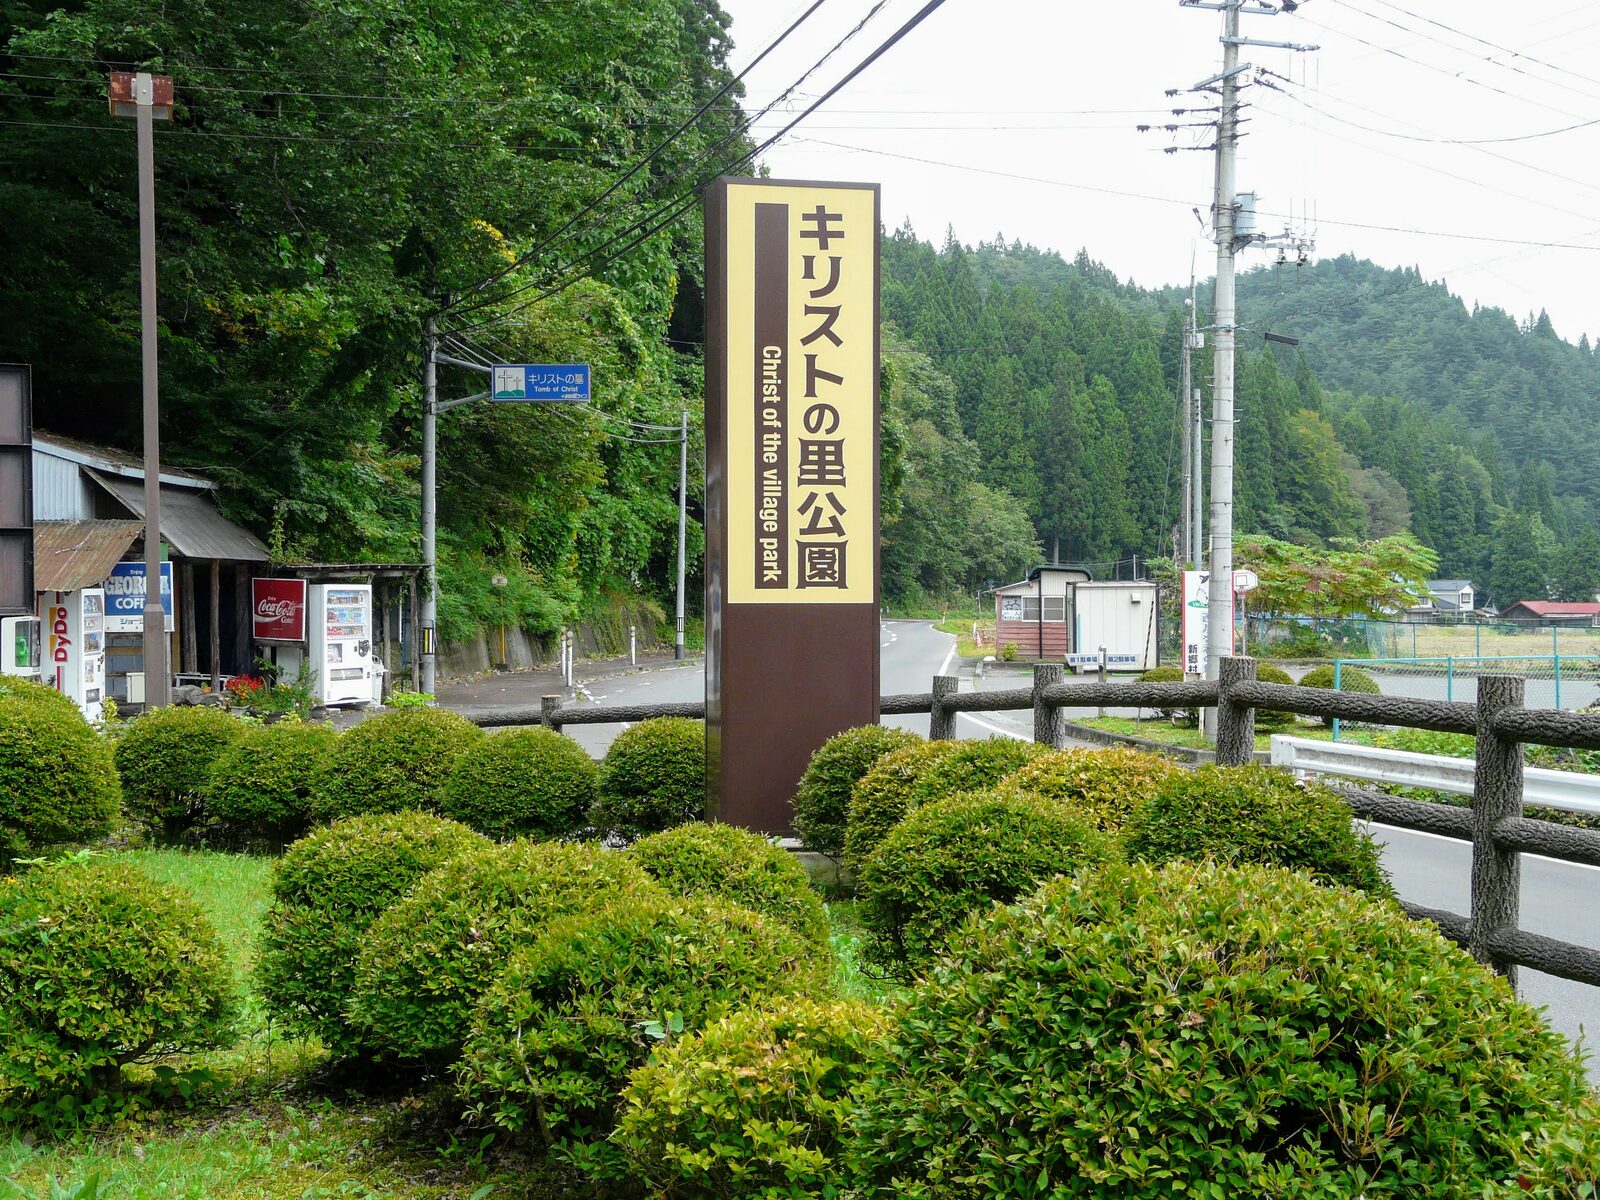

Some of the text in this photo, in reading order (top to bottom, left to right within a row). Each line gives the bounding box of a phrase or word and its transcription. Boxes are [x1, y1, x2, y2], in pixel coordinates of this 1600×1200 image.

[528, 374, 584, 385] キリストの墓
[795, 204, 849, 590] キリストの里公園
[759, 345, 782, 582] Christ of the village park
[104, 575, 171, 596] GEORA
[258, 599, 297, 617] Coca-Cola
[54, 606, 72, 663] DyDo
